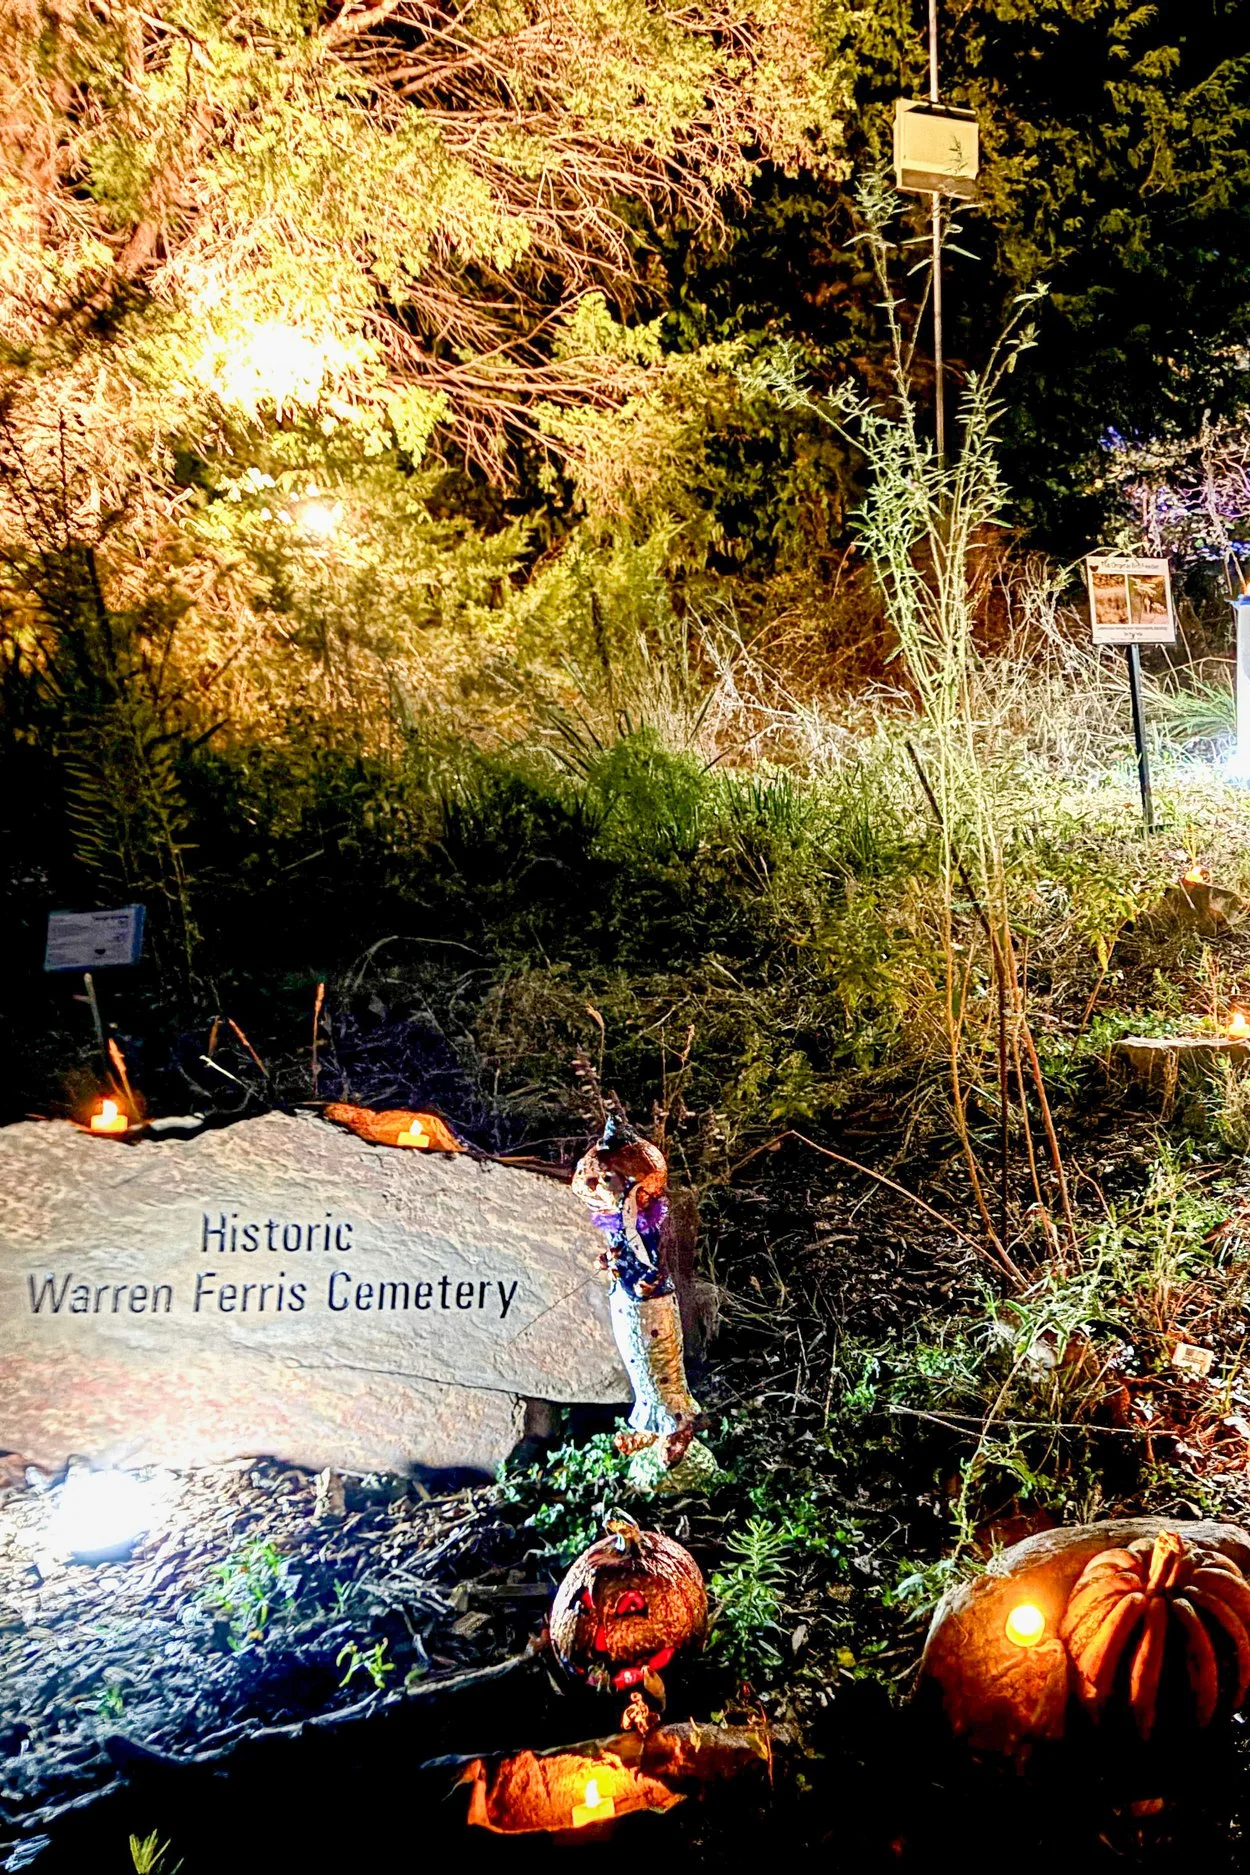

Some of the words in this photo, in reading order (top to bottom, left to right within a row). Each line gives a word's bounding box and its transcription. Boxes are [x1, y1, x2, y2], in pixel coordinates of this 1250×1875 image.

[200, 1212, 353, 1253] Historic
[27, 1272, 172, 1314] Warren
[193, 1271, 307, 1312] Ferris
[328, 1270, 519, 1318] Cemetery
